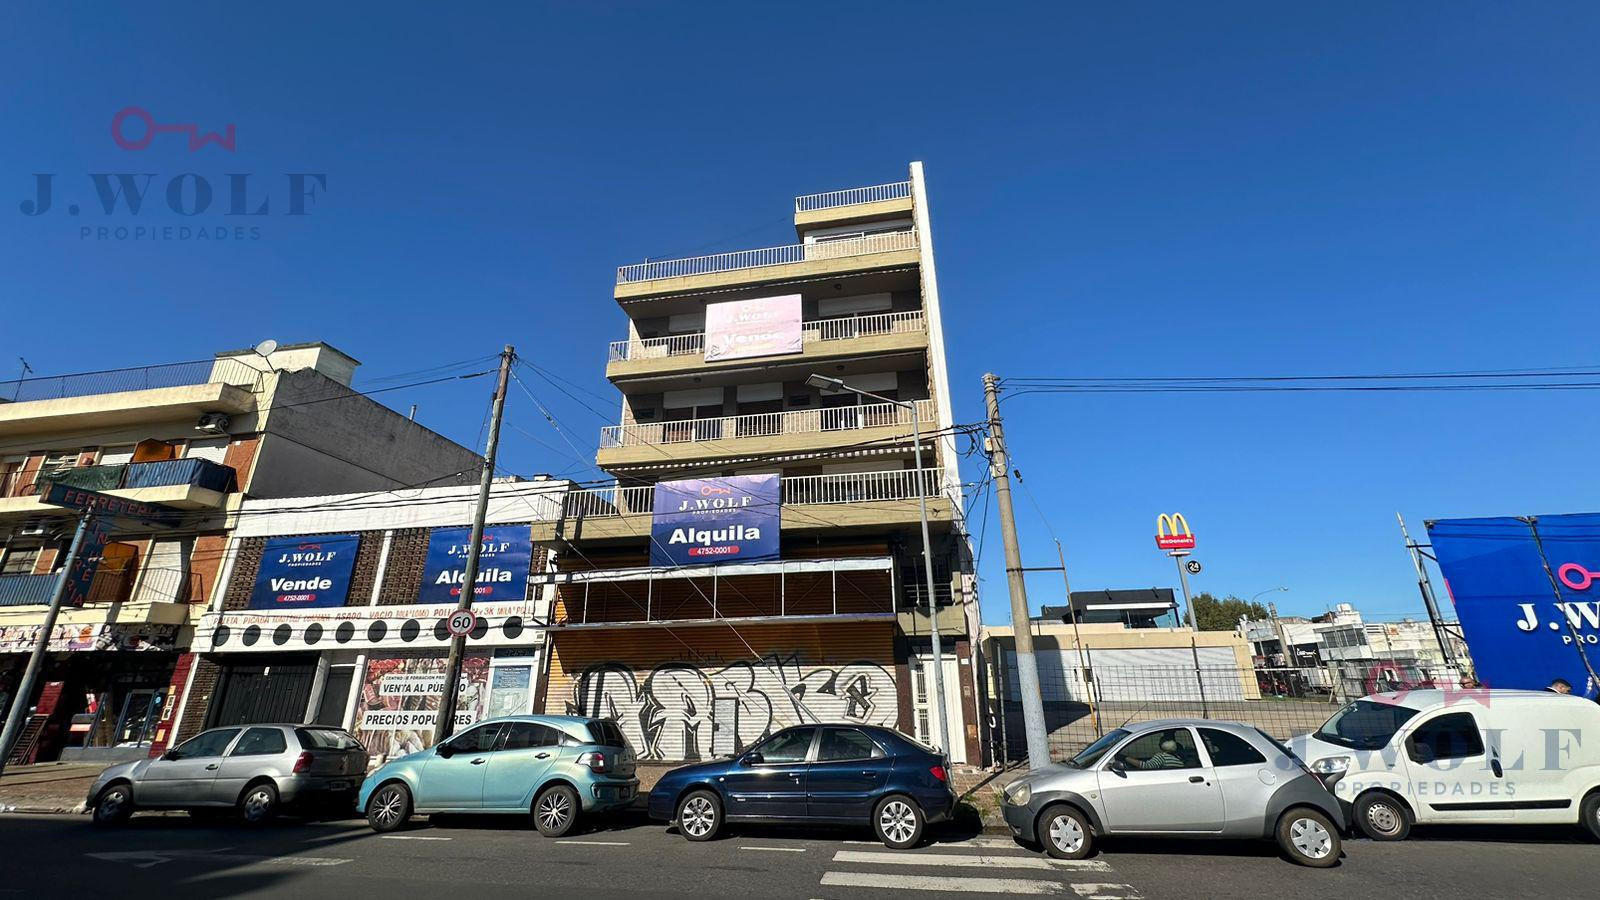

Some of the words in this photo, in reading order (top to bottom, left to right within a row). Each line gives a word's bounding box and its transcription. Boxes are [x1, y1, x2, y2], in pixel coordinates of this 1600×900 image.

[678, 496, 752, 512] J.WOLF
[668, 525, 760, 546] Alquila
[278, 551, 337, 563] J.WOLF
[696, 547, 731, 555] 4752-0001
[271, 577, 332, 592] Vende
[452, 616, 471, 629] 60
[383, 683, 411, 693] VENTA
[414, 683, 426, 693] AL
[365, 714, 409, 726] PRECIOS
[411, 714, 472, 726] POPURES
